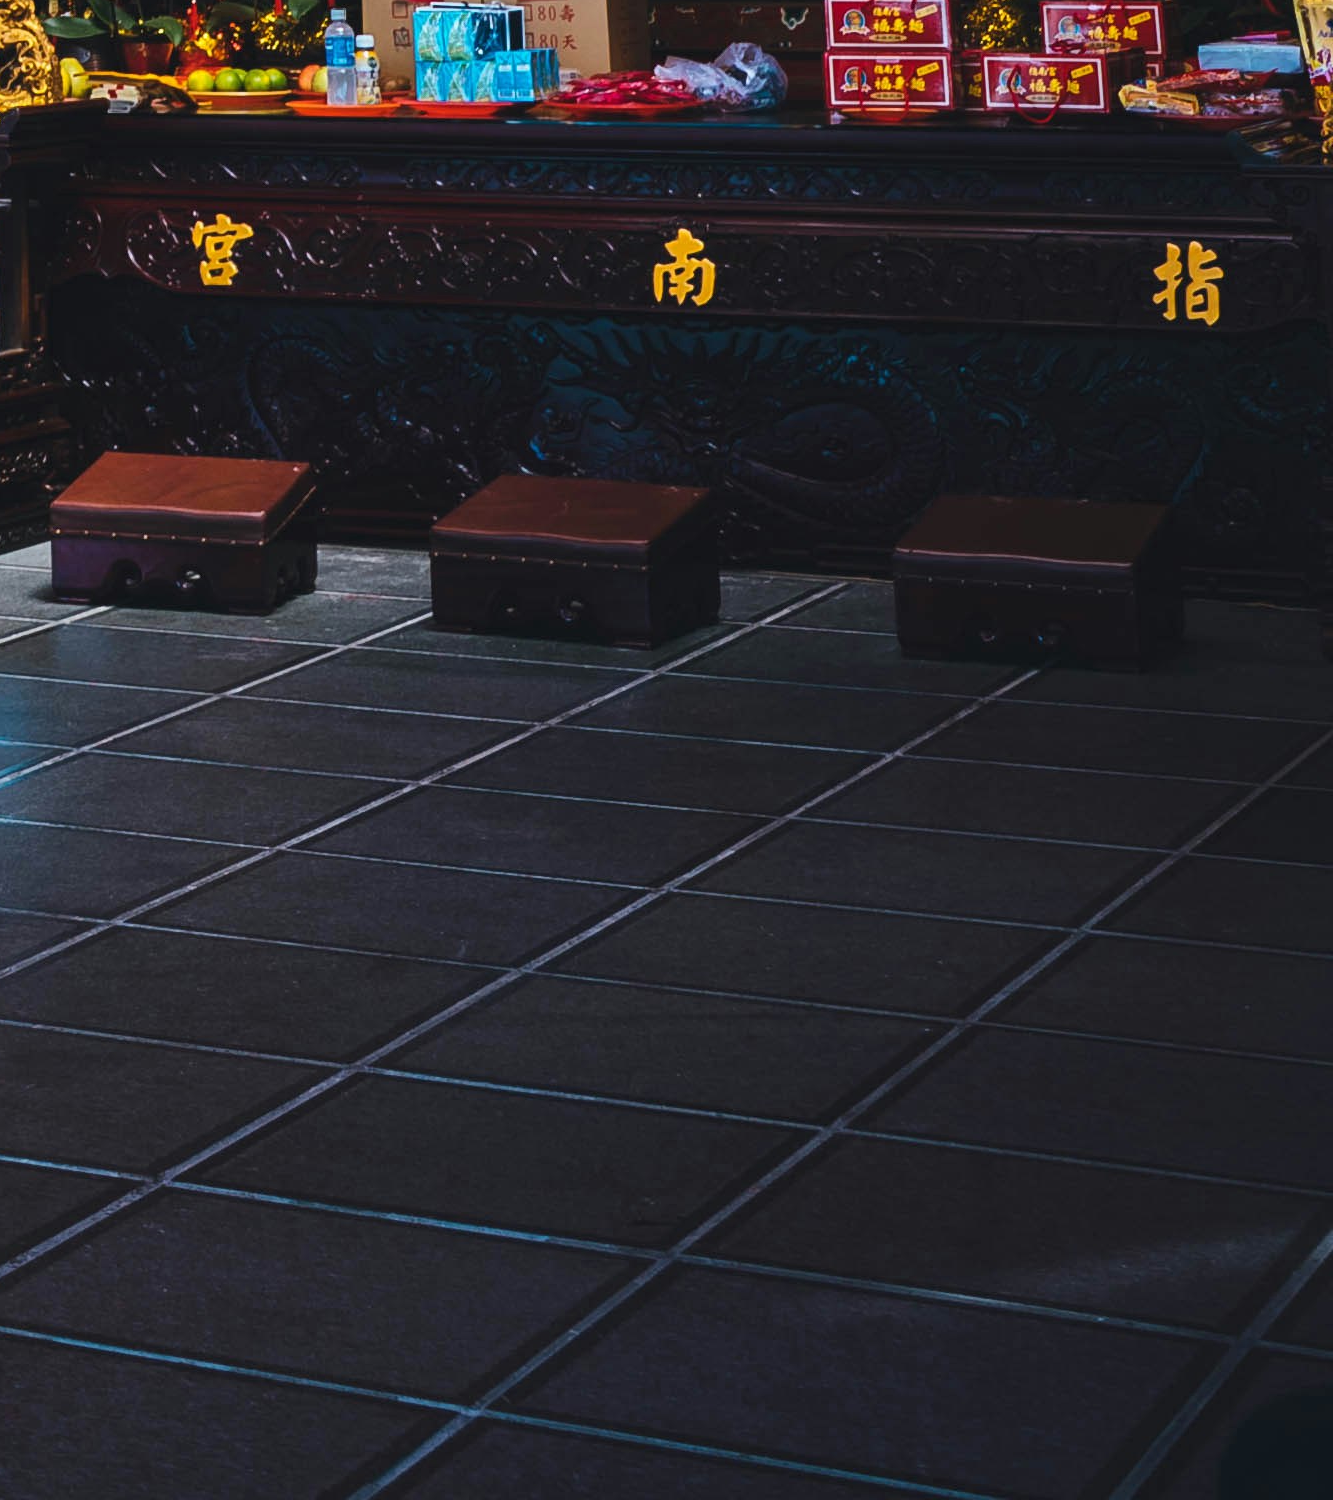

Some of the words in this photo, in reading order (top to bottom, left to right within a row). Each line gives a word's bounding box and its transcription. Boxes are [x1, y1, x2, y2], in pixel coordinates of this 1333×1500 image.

[190, 213, 252, 285] 宮
[652, 228, 716, 304] 南
[1154, 241, 1223, 326] 指
